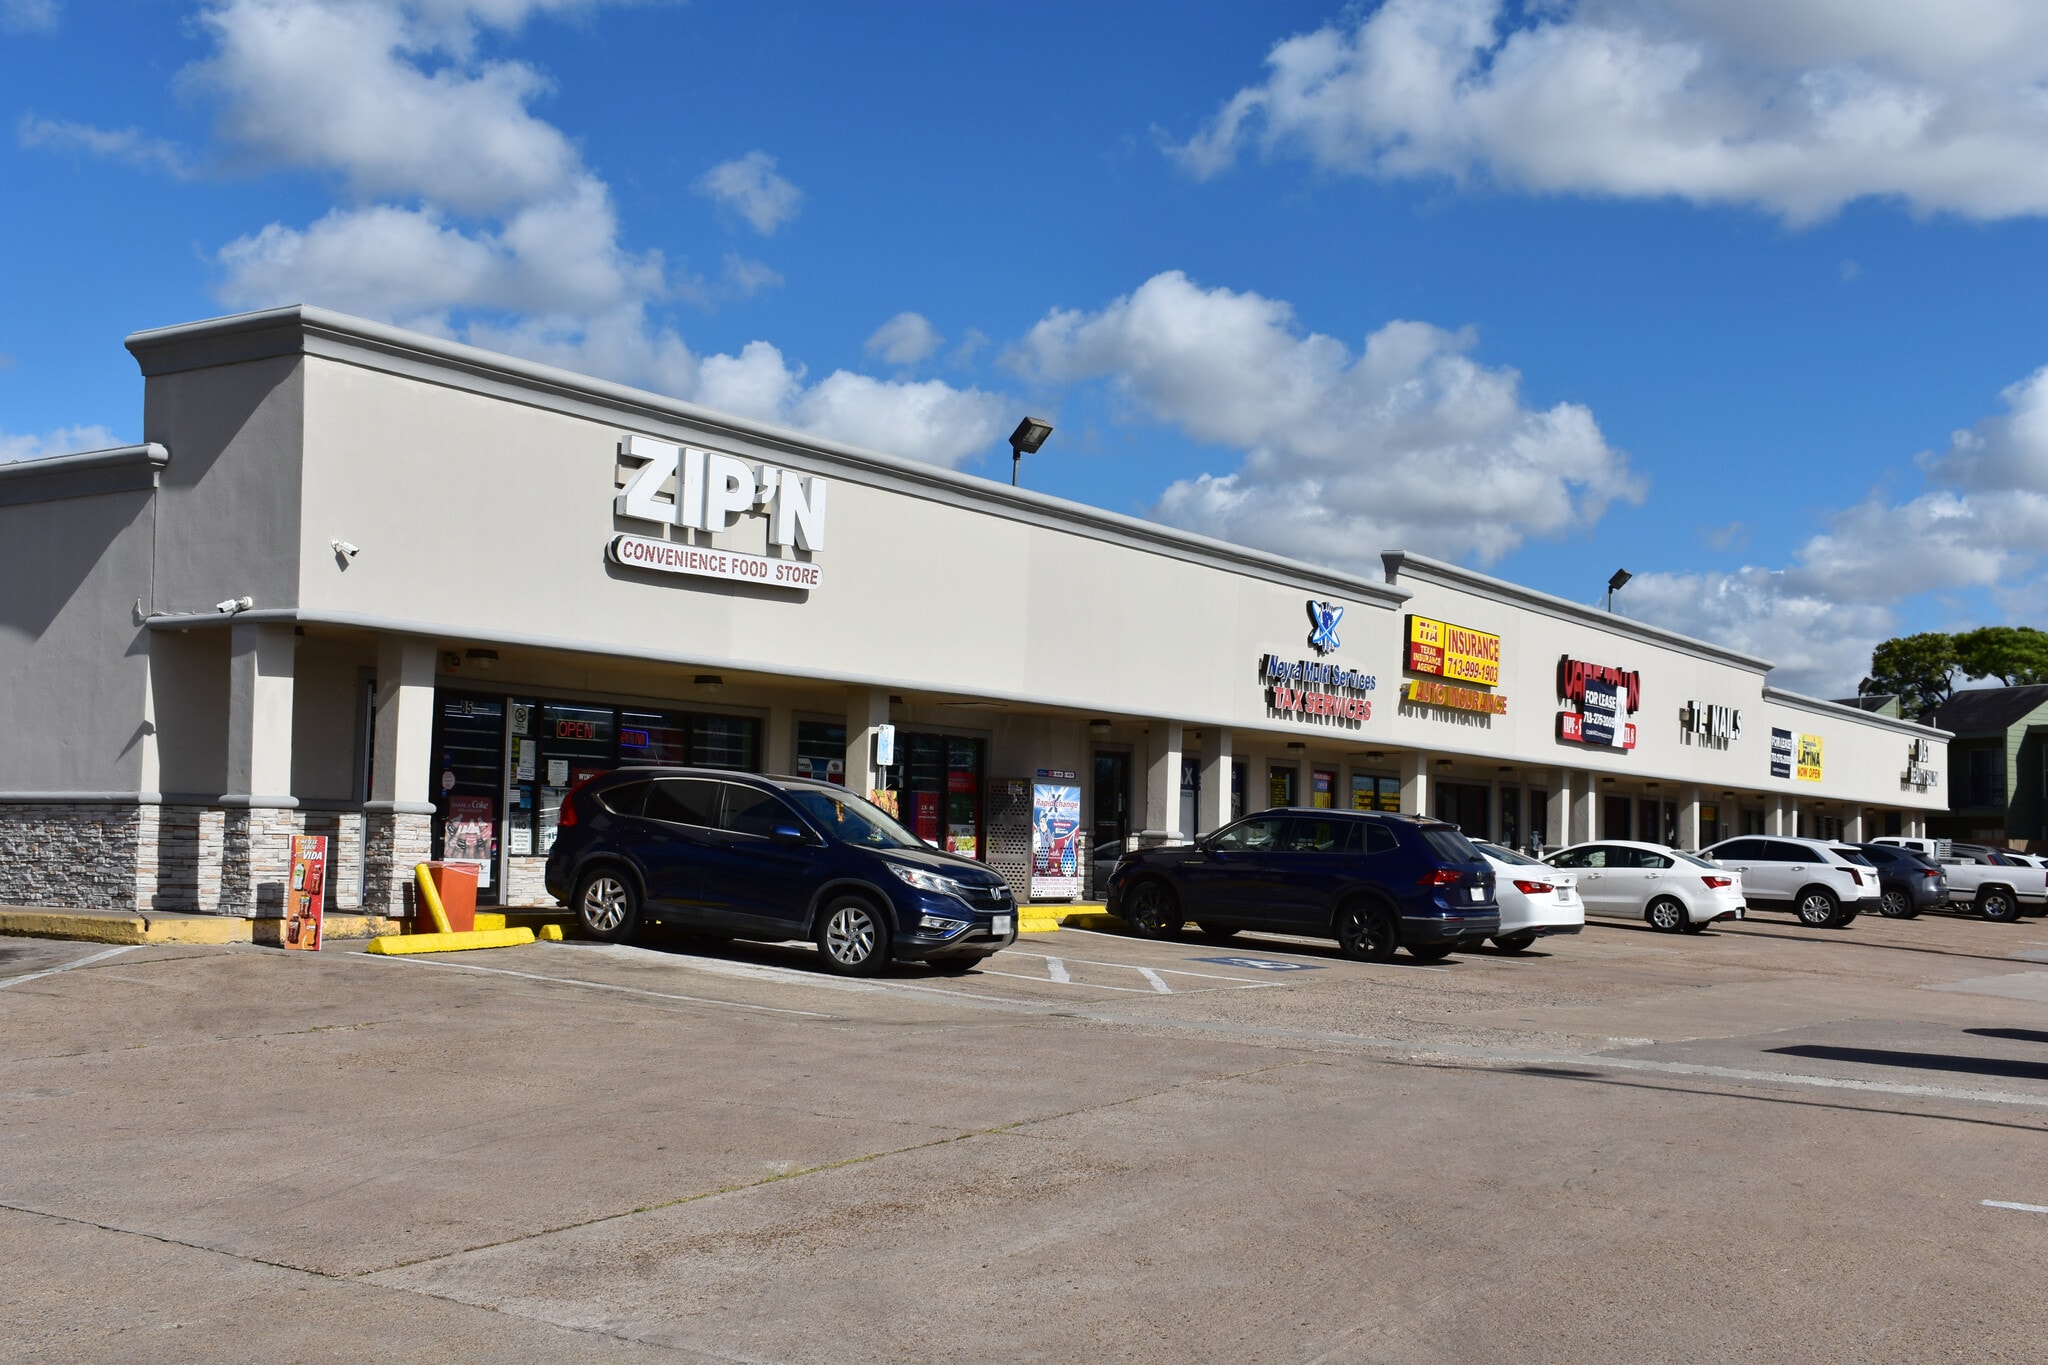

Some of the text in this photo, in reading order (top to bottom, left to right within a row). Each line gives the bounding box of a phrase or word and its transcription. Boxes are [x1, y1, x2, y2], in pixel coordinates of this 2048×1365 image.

[616, 434, 827, 552] ZIP'N
[623, 540, 819, 586] CONVENIENCE FOOD STORE
[1420, 644, 1437, 656] TEXAS
[1448, 628, 1499, 662] INSURANCE
[1413, 652, 1441, 666] INSURANCE
[1416, 661, 1437, 674] AGENCY
[1267, 654, 1376, 690] Neyra Multi Services
[1448, 657, 1498, 682] 713-999-1903
[1275, 686, 1372, 721] TAX SERVICES
[1415, 680, 1507, 715] AUTO INSURANCE
[1585, 690, 1616, 709] FOR LEASE
[558, 721, 593, 739] OPEN
[1711, 705, 1743, 741] NAILS
[621, 731, 645, 746] ATM
[1798, 750, 1821, 768] LATINA
[1798, 767, 1808, 777] NOW
[1808, 768, 1821, 779] OPEN
[471, 800, 489, 809] Coke
[514, 821, 527, 830] NO
[303, 851, 322, 860] VIDA
